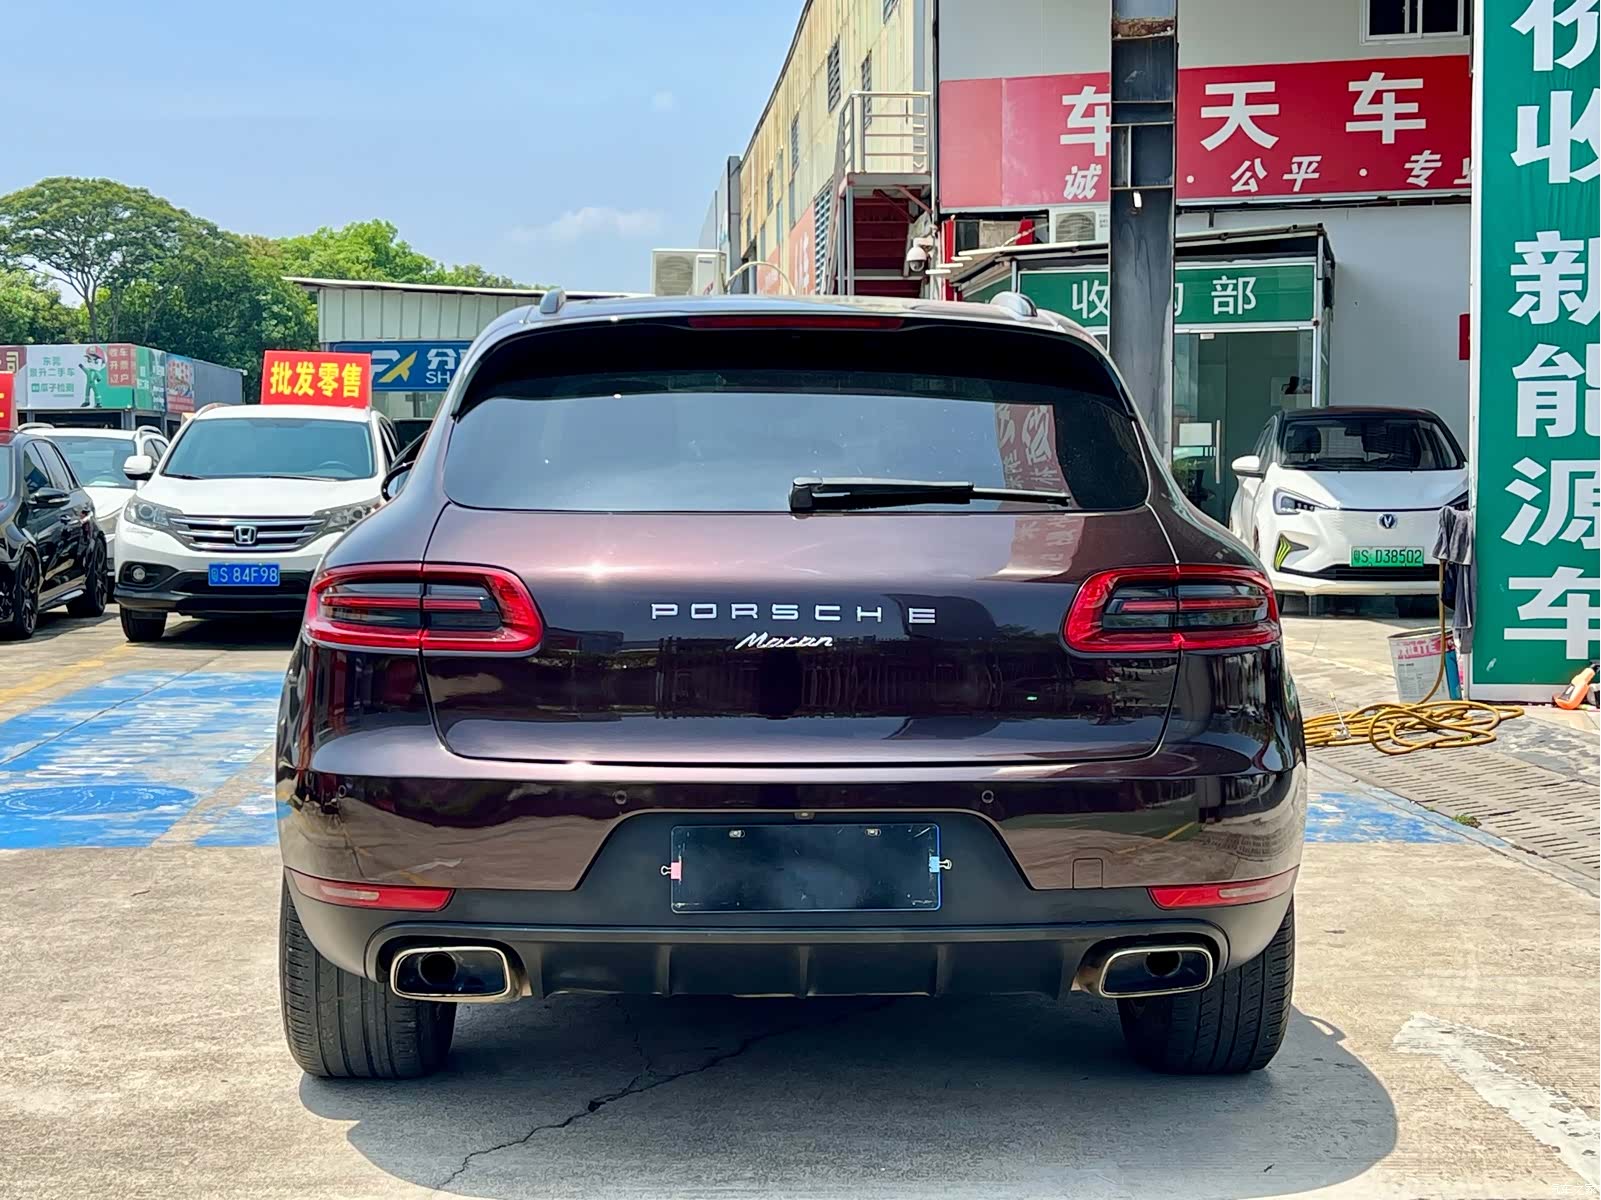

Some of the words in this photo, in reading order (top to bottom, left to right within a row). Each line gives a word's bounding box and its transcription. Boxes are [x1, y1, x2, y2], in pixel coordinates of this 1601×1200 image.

[1230, 154, 1323, 193] 公平
[1070, 274, 1258, 320] 收部
[269, 360, 363, 399] 批发零售
[650, 602, 937, 625] PORSCHE
[733, 631, 834, 651] Macan
